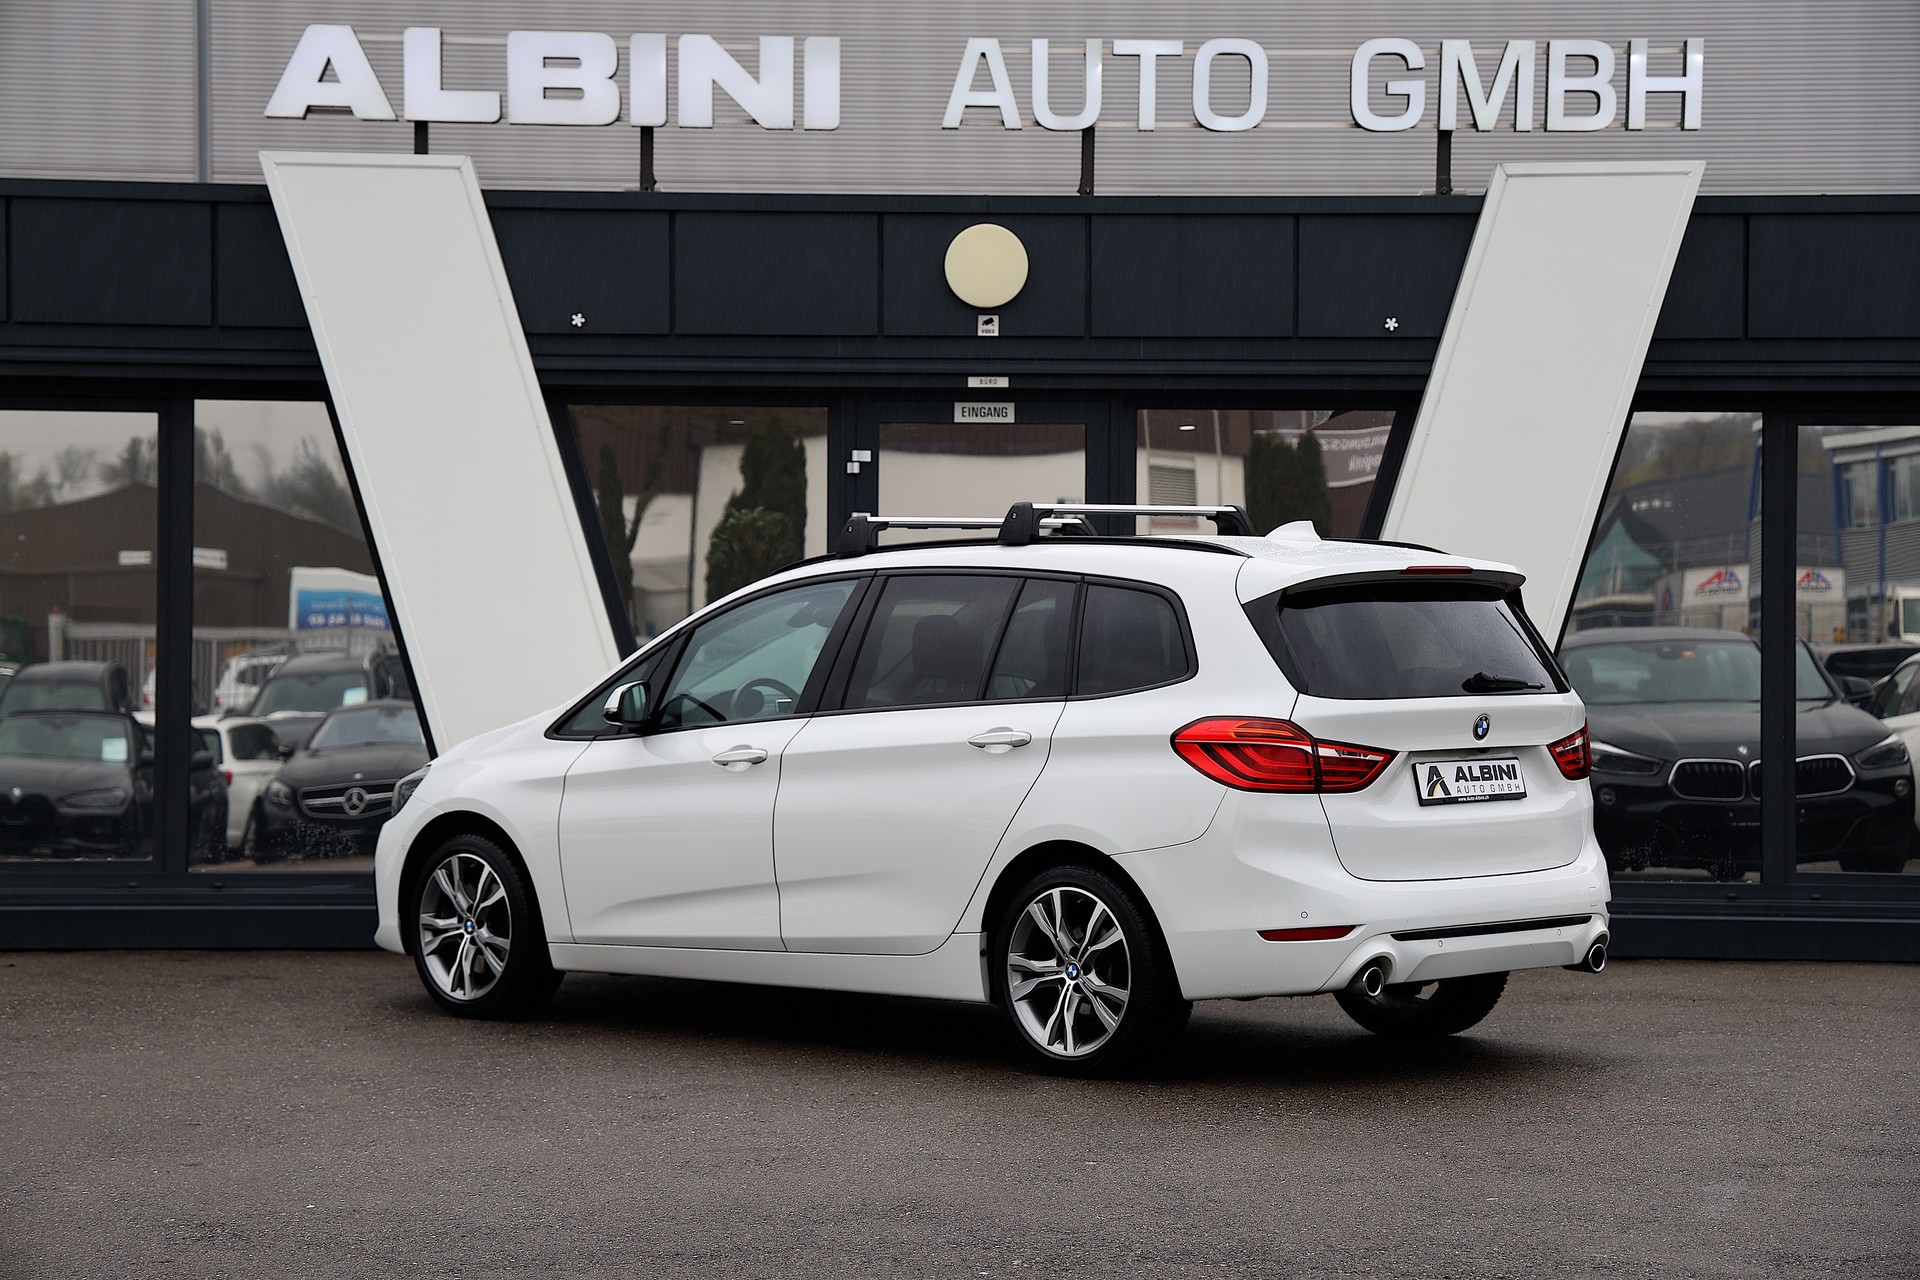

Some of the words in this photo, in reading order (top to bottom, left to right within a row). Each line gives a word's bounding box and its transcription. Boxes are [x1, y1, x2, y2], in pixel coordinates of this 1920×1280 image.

[263, 23, 841, 130] ALBINI
[942, 36, 1269, 132] AUTO
[1349, 36, 1705, 132] GMBH
[961, 406, 1009, 418] EINGANG
[1455, 764, 1518, 782] ALBINI
[1456, 784, 1485, 794] AUTO
[1490, 783, 1520, 793] GMBH
